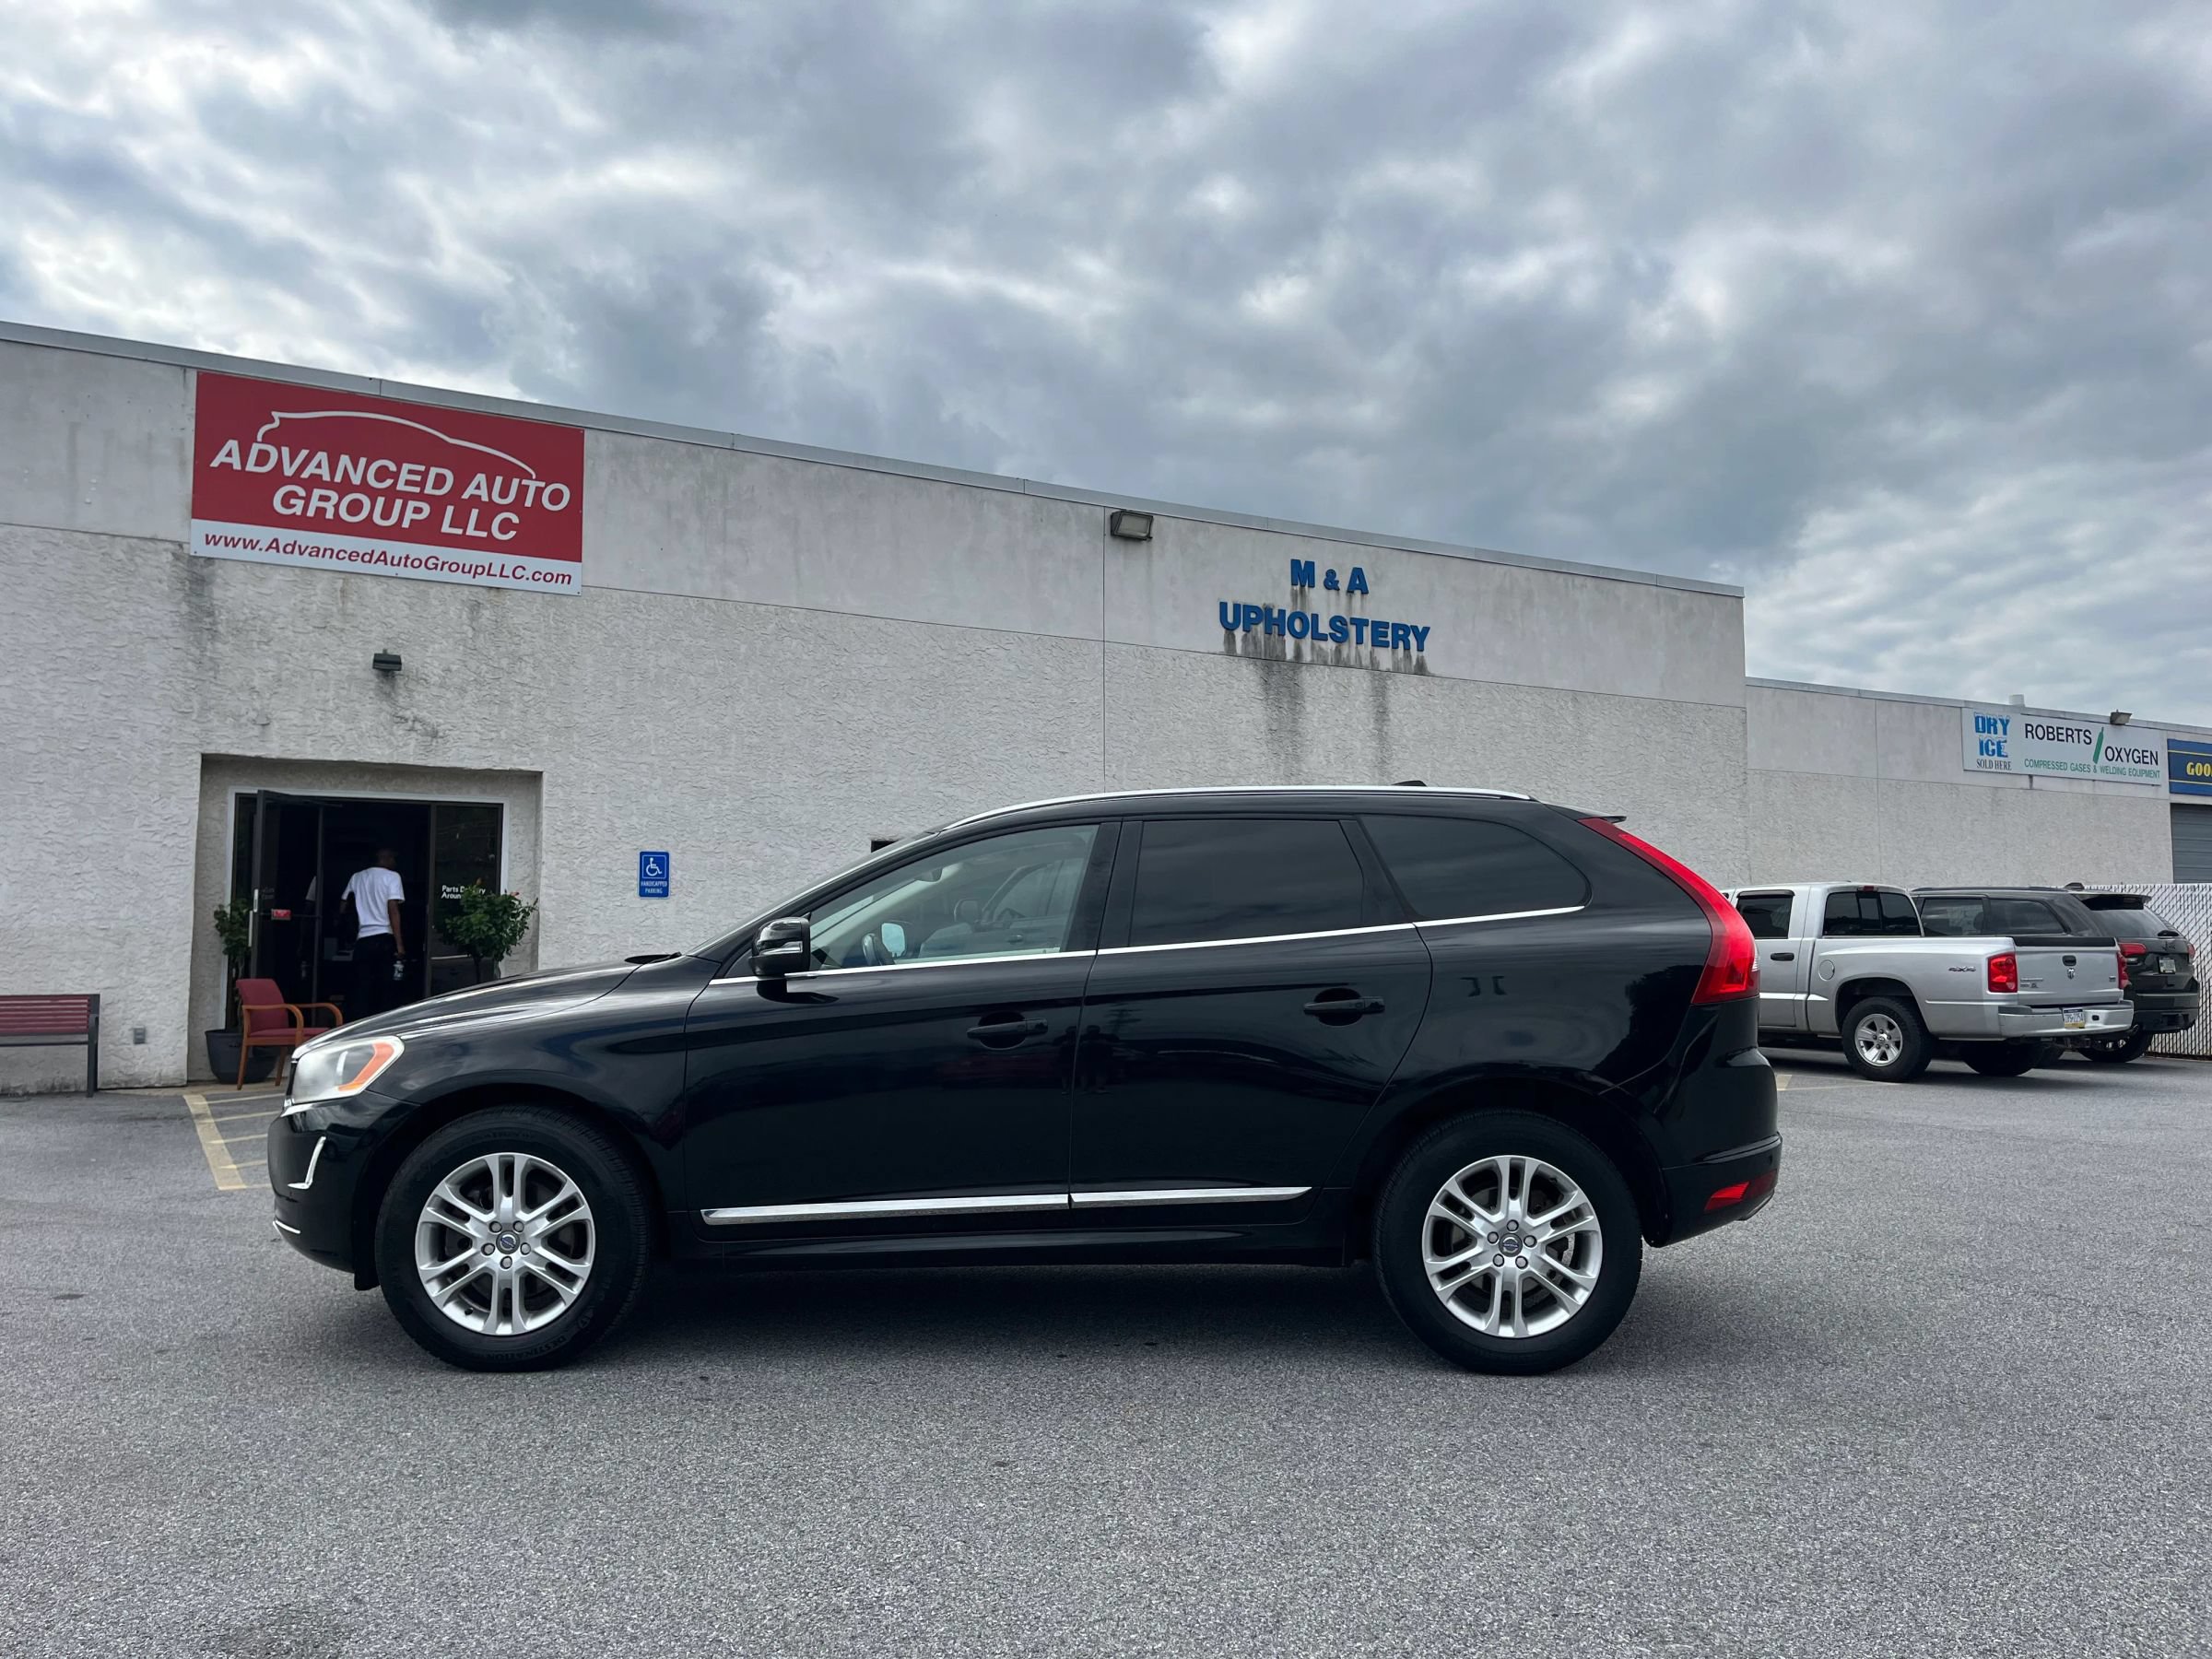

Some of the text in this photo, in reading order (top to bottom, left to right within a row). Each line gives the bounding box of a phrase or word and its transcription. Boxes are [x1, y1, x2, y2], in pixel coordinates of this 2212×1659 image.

[210, 439, 571, 512] ADVANCED AUTO
[272, 485, 521, 541] GROUP LLC
[204, 532, 571, 586] www.AdvancedAutoGroupLLC.com
[1290, 559, 1369, 594] M & A
[1219, 602, 1430, 652] UPHOLSTERY
[1974, 715, 2010, 735] DRY
[2025, 724, 2092, 745] ROBERTS
[1979, 738, 2008, 758] ICE
[2104, 746, 2159, 766] OXYGEN
[1976, 759, 2012, 771] SOLD HERE
[2024, 759, 2160, 779] COMPRESSED GASES & WELDING EQUIPMENT
[2186, 761, 2212, 777] GOO
